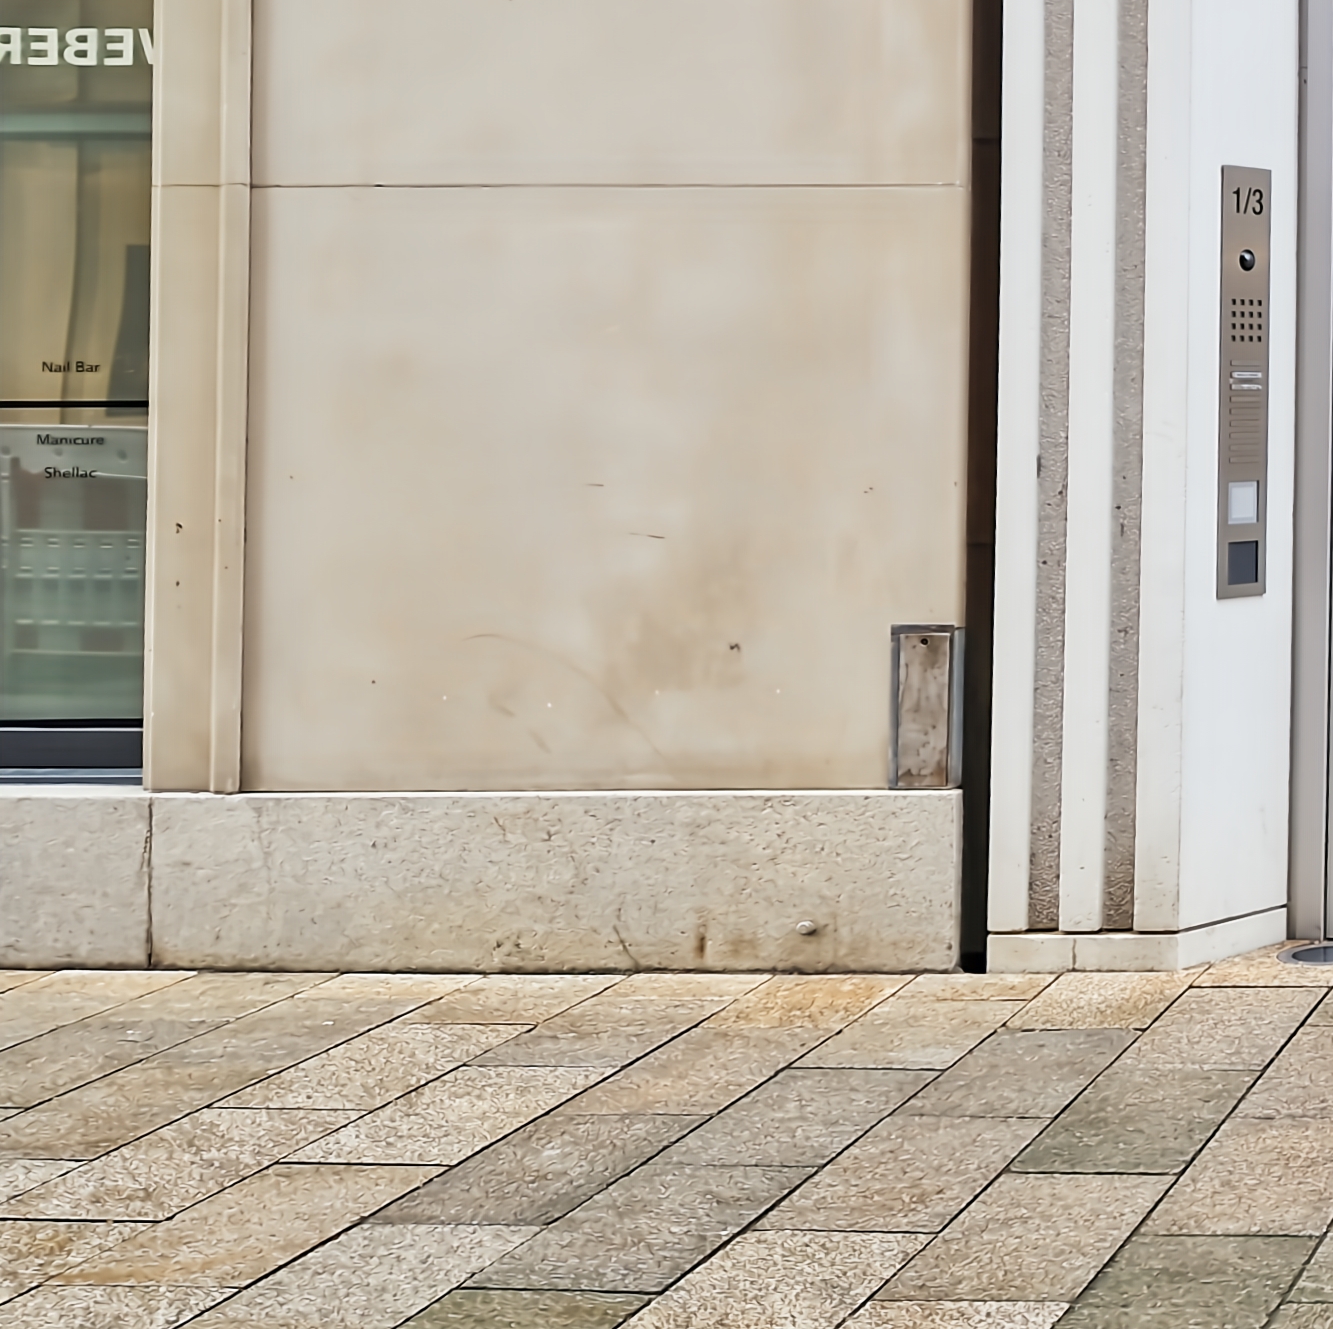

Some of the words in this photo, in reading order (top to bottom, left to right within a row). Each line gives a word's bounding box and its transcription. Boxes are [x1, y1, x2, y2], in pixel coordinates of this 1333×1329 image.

[1232, 186, 1264, 216] 1/3
[42, 361, 70, 373] Nail
[75, 361, 101, 373] Bar
[36, 434, 105, 445] Manicure
[44, 467, 98, 479] Shellac
